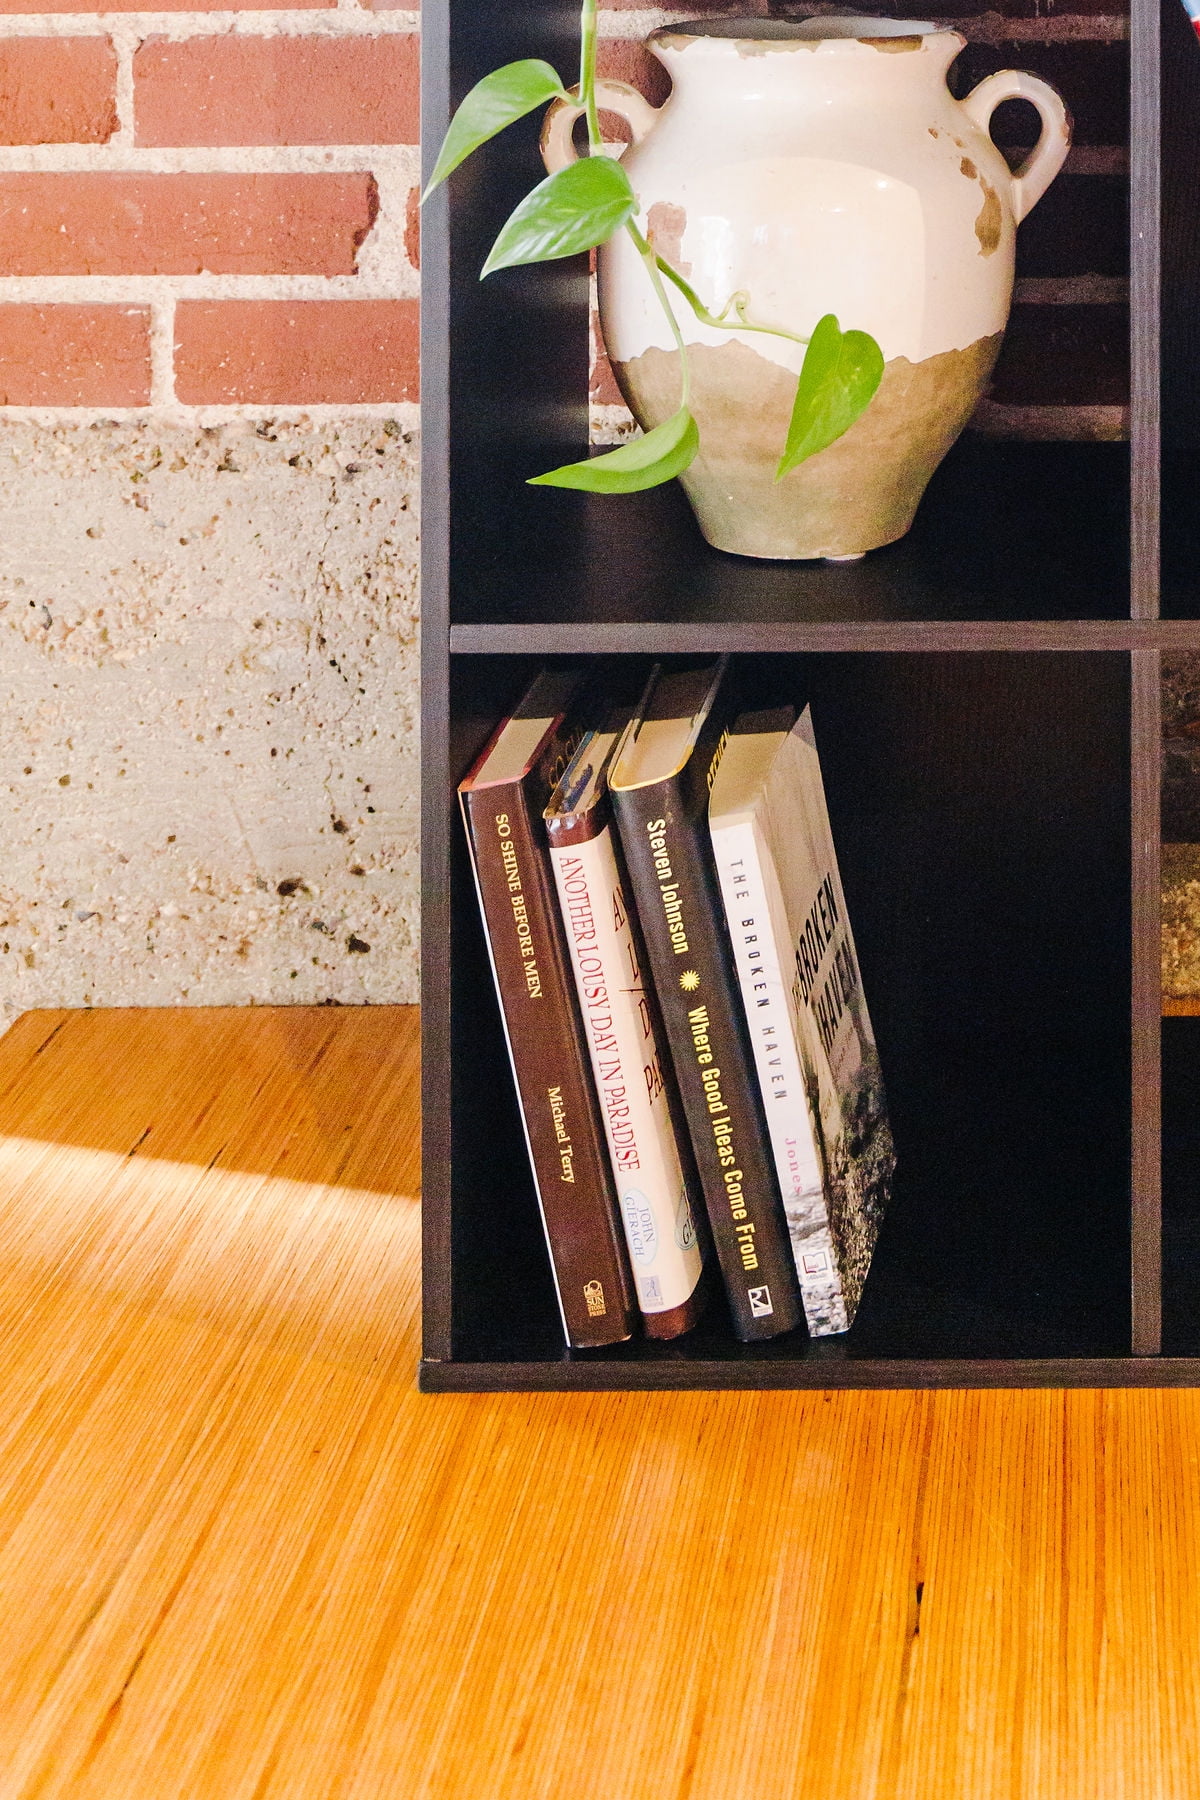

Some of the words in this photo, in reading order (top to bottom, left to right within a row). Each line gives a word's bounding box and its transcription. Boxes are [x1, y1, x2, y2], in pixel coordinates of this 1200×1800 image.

[496, 813, 511, 837] SO
[646, 818, 673, 880] Steven
[501, 840, 522, 892] SHINE
[511, 894, 535, 958] BEFORE
[559, 857, 596, 942] ANOTHER
[660, 883, 689, 955] Johnson
[795, 871, 839, 1008] BROKEN
[523, 960, 543, 999] MEN
[576, 944, 611, 1010] LOUSY
[731, 859, 750, 900] THE
[741, 918, 770, 1008] BROKEN
[762, 1026, 788, 1100] HAVEN
[817, 932, 857, 1054] HAVEN
[590, 1015, 619, 1052] DAY
[688, 1005, 713, 1064] Where
[599, 1058, 624, 1081] IN
[701, 1067, 728, 1114] Good
[547, 1086, 571, 1143] Michael
[559, 1145, 575, 1183] Terry
[604, 1086, 640, 1172] PARADISE
[712, 1109, 735, 1167] Ideas
[724, 1169, 748, 1221] Come
[785, 1137, 803, 1195] Jones
[625, 1196, 645, 1256] GIERACH
[638, 1207, 655, 1242] JOHN
[736, 1223, 759, 1271] From
